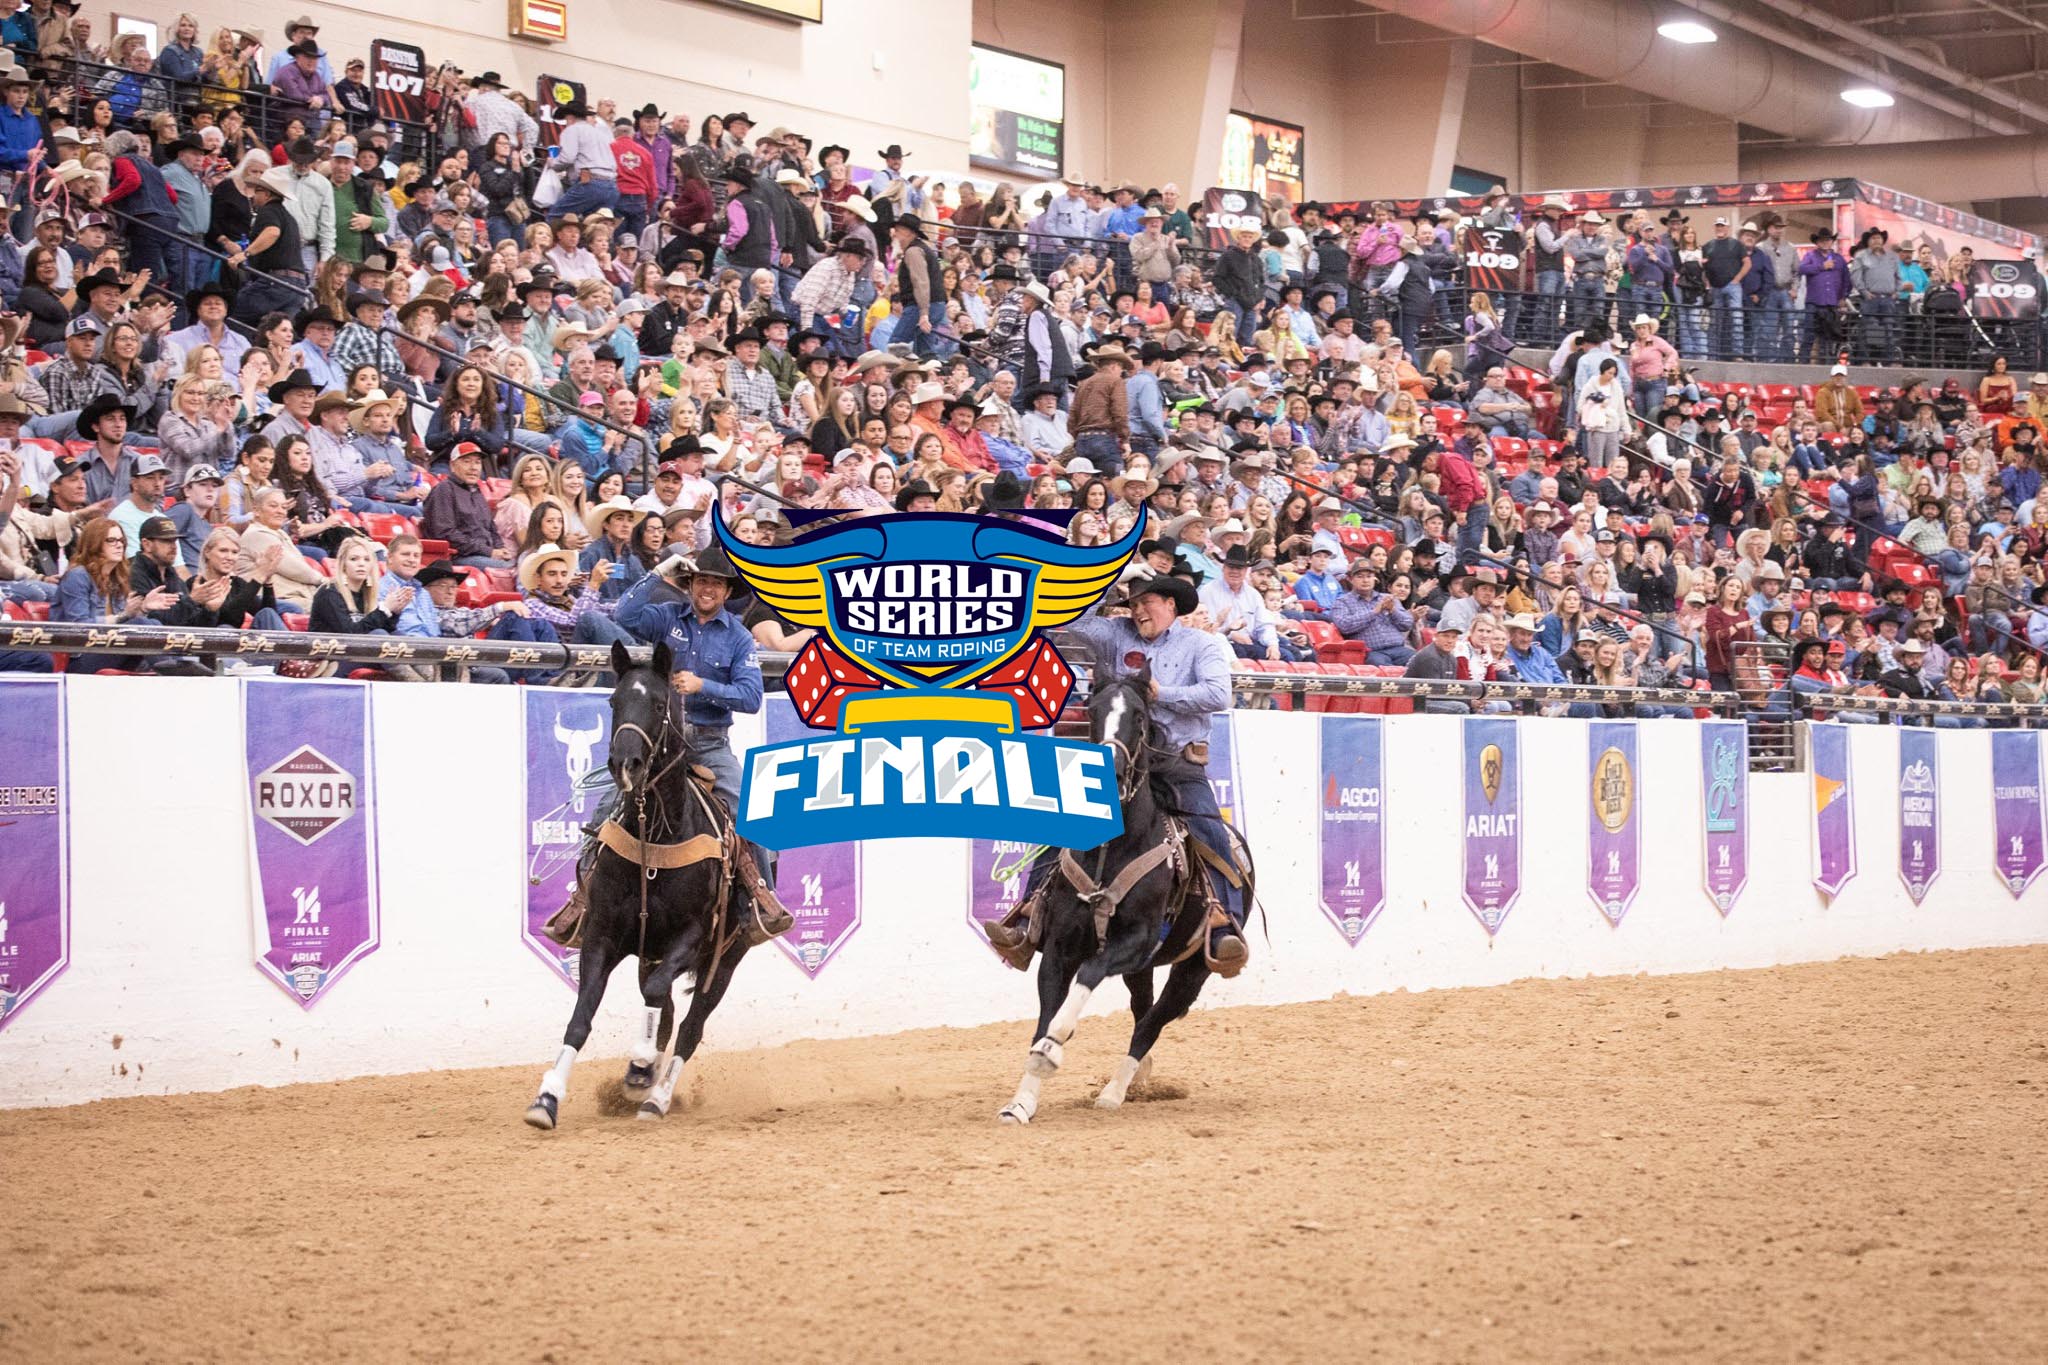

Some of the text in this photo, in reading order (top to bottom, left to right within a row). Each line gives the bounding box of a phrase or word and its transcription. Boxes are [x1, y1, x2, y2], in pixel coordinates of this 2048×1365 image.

[375, 70, 424, 96] 107
[1466, 251, 1519, 270] 109
[1974, 283, 2037, 299] 109
[12, 786, 57, 807] TRUCKS
[260, 782, 352, 808] ROXOR
[1341, 787, 1380, 807] AGCO
[1466, 814, 1516, 837] ARIAT
[801, 873, 823, 906] 14
[291, 885, 321, 924] 14
[795, 908, 830, 917] FINALE
[284, 926, 330, 937] FINALE
[291, 952, 323, 962] ARIAT
